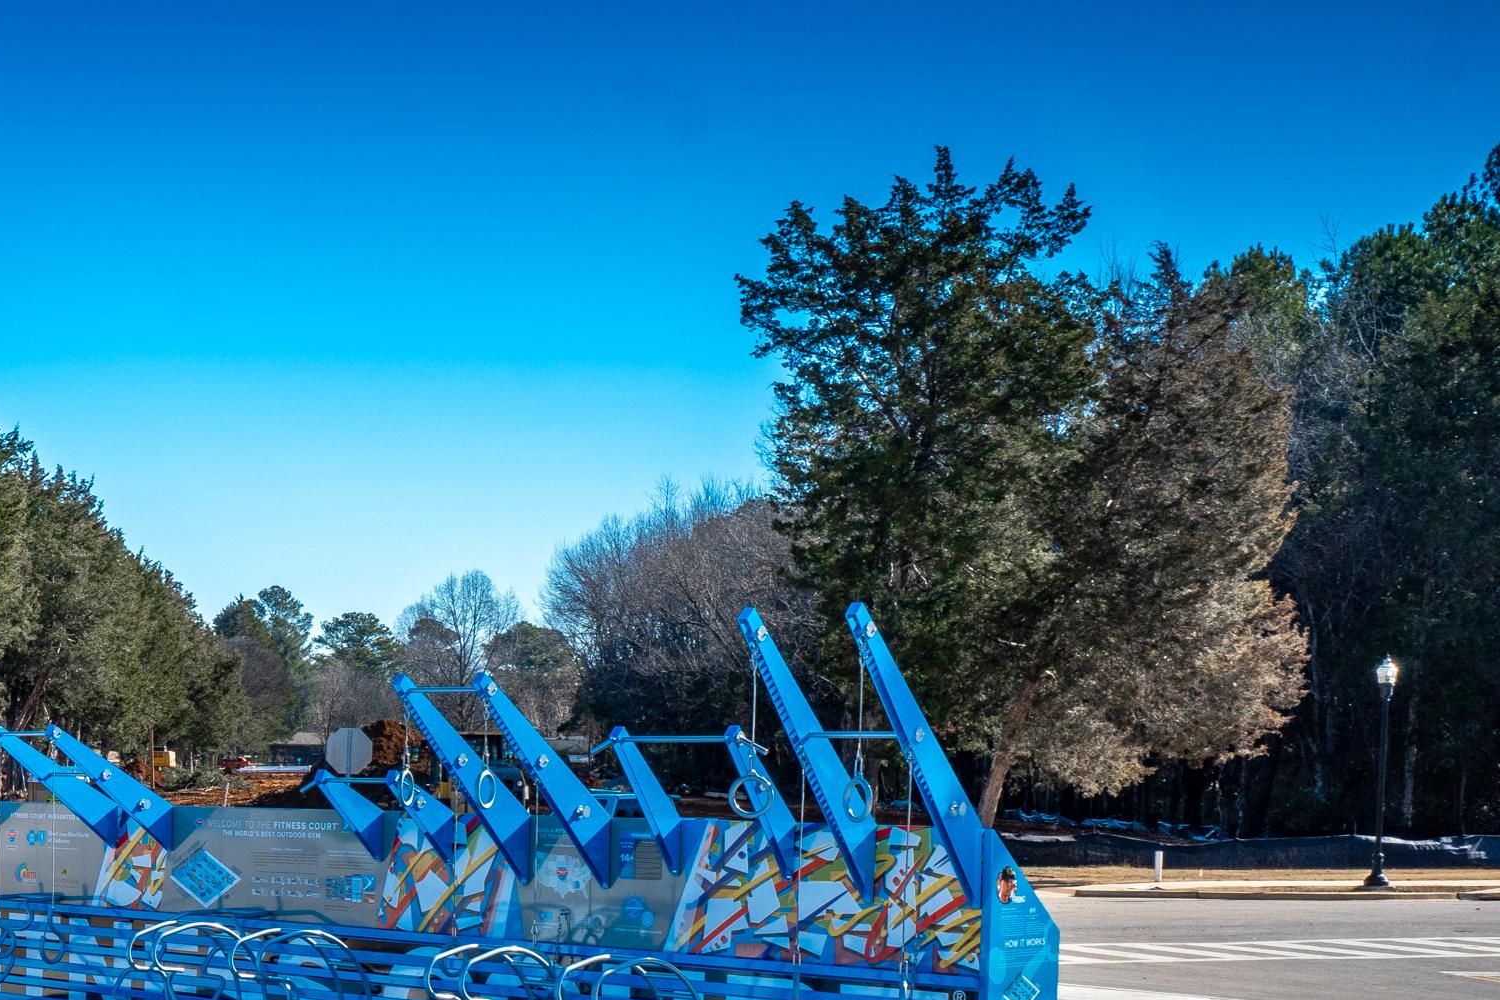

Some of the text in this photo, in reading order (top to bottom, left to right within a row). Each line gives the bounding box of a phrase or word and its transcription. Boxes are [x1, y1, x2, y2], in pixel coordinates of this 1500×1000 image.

[206, 819, 243, 829] WELCOME
[244, 820, 254, 829] TO
[256, 820, 270, 829] THE
[273, 821, 307, 830] FITNESS
[620, 854, 634, 862] 14+
[1004, 937, 1046, 949] HOW IT WORKS
